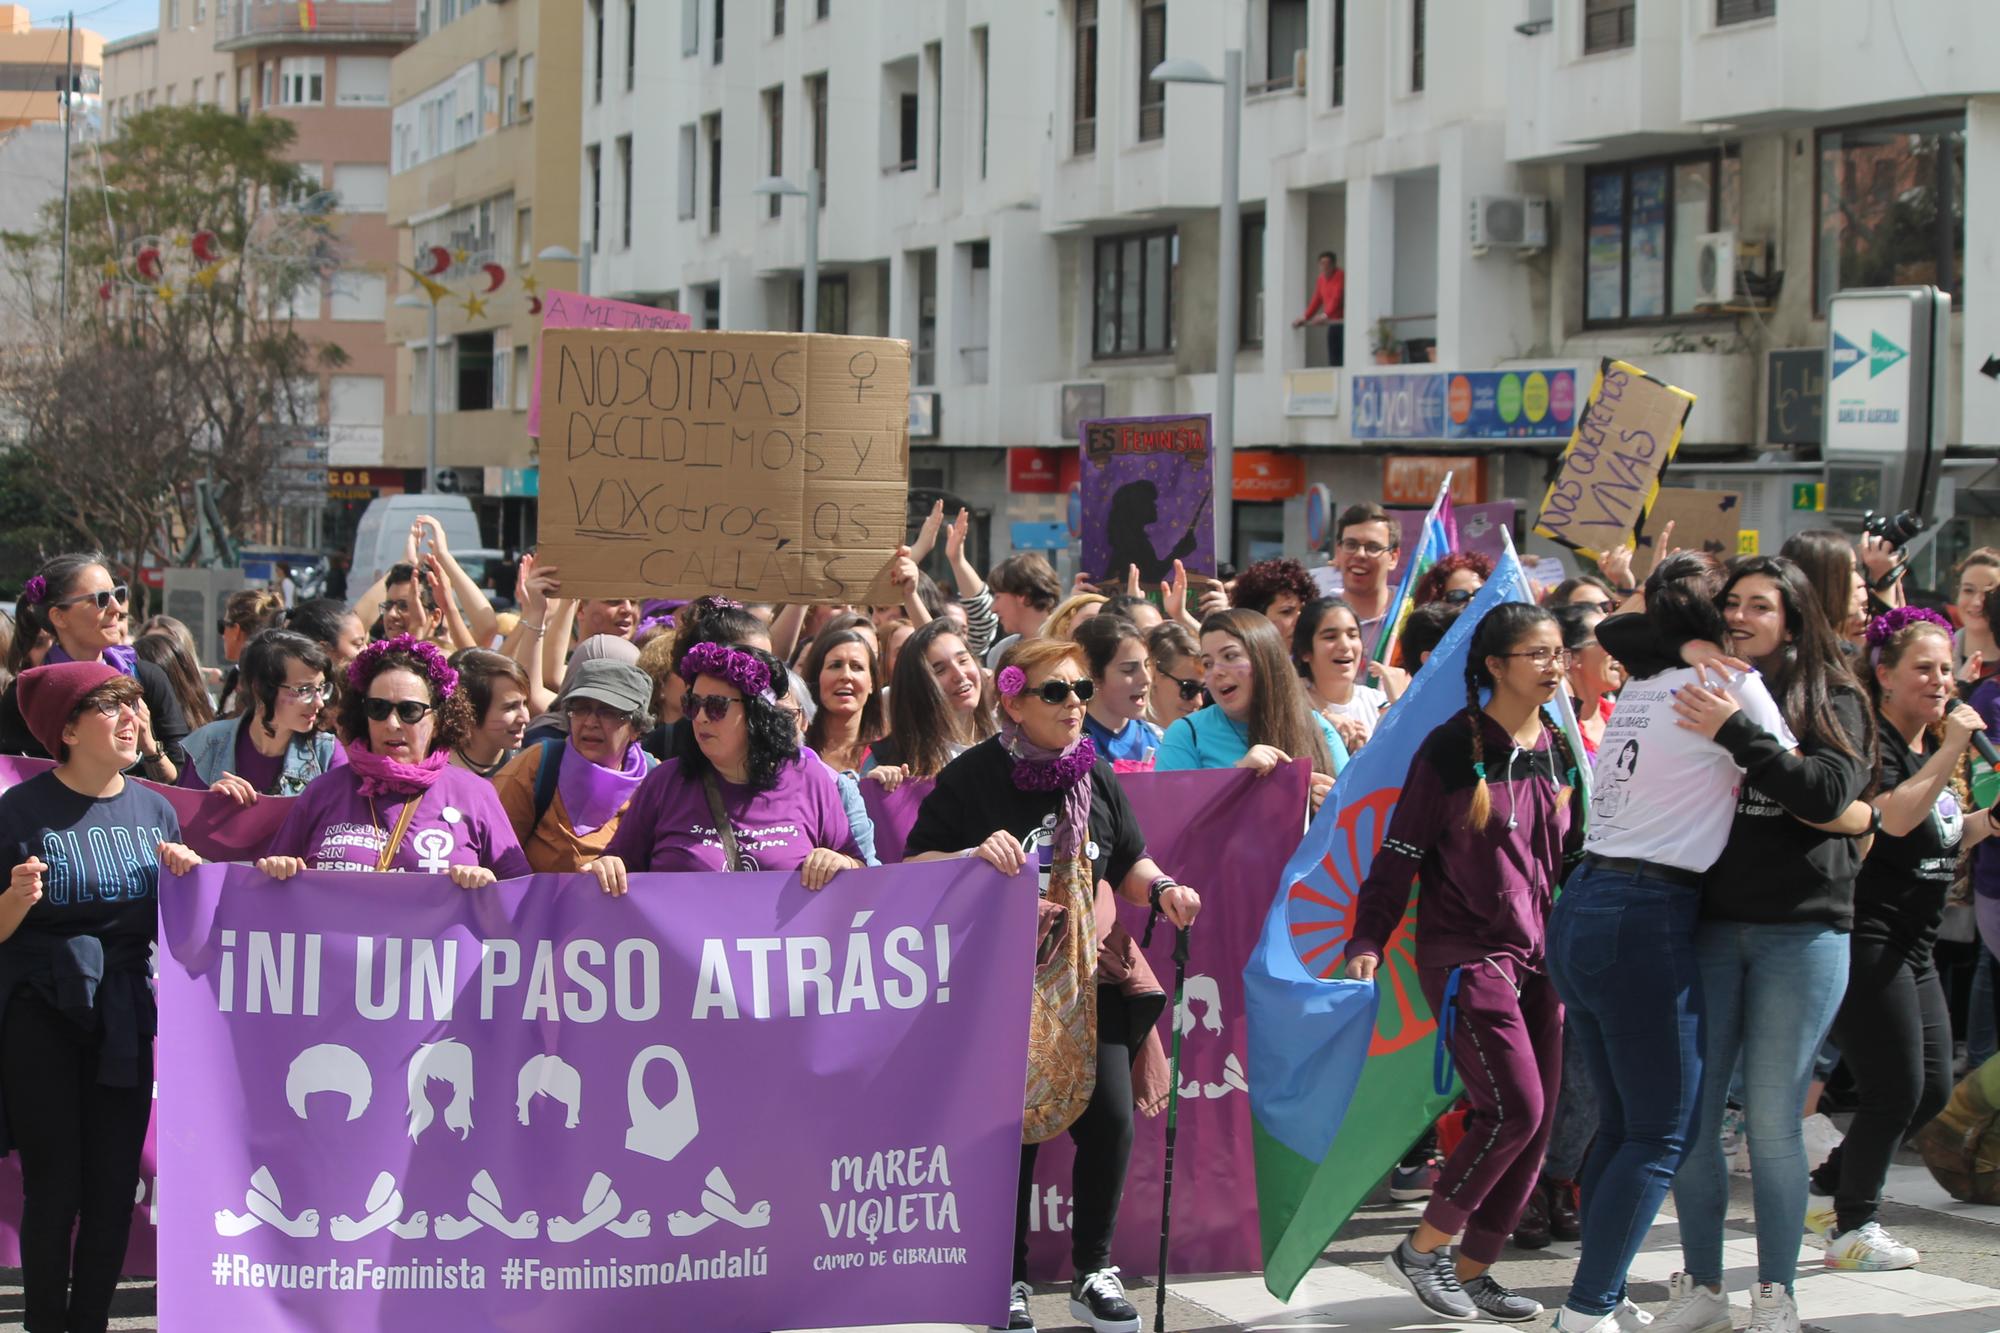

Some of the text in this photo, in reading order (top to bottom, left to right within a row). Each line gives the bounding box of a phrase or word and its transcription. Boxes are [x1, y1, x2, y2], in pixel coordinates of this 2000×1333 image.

[546, 298, 568, 321] A
[558, 344, 802, 416] NOSOTRAS
[567, 411, 873, 475] DECIDIMOS Y
[1089, 429, 1115, 453] ES
[1539, 371, 1629, 537] NOS QUEREMOS
[813, 502, 870, 542] OS
[317, 846, 345, 859] SIN
[218, 910, 952, 1024] ¡NI UN PASO ATRÁS!
[831, 1144, 952, 1193] MAREA
[819, 1191, 961, 1245] VIOLETA
[211, 1246, 769, 1291] #RevuertaFeminista #FeminismoAndalú
[813, 1246, 968, 1271] CAMPO DE GIBRALTAR
